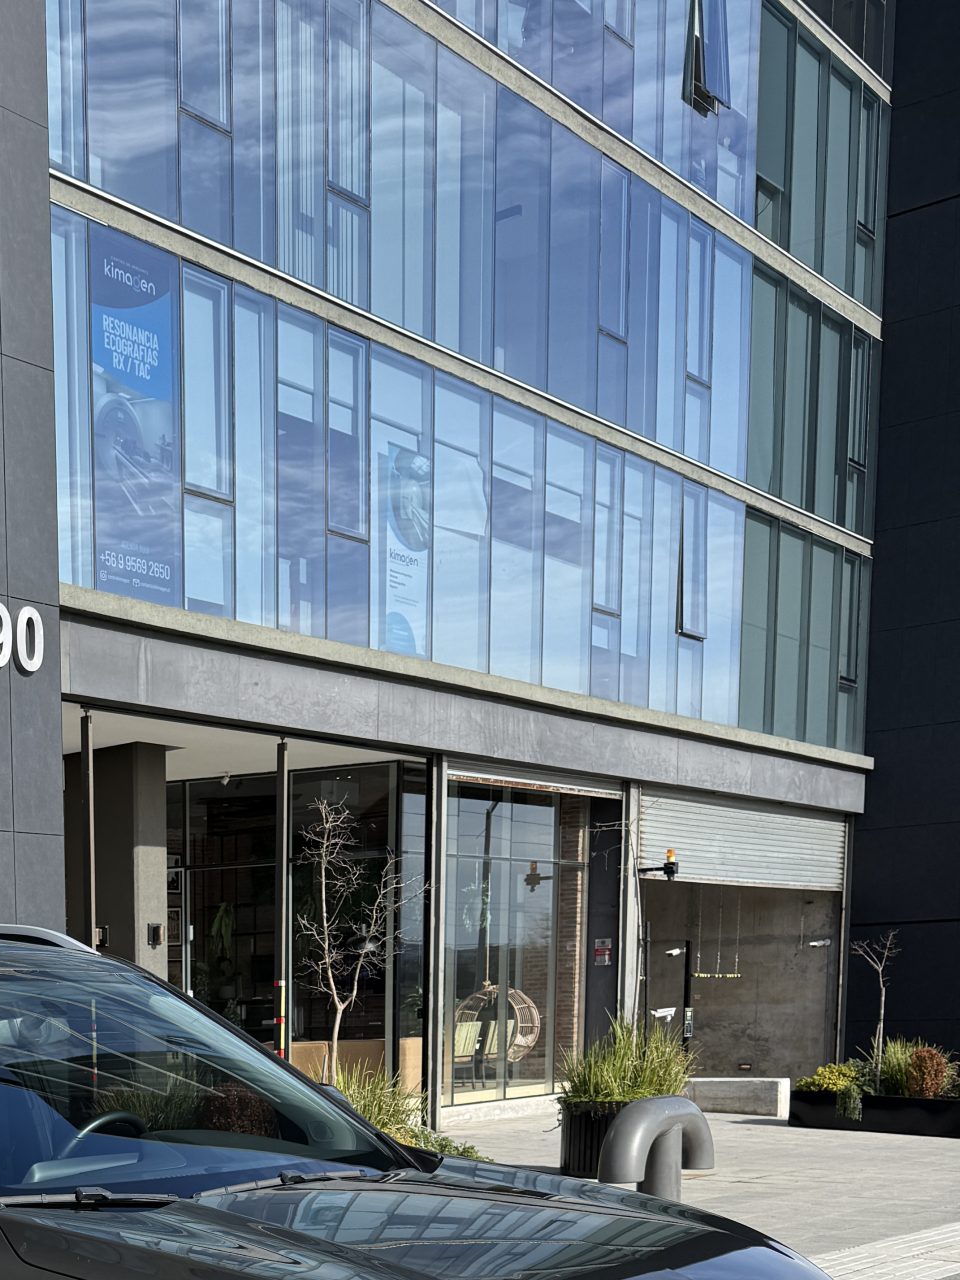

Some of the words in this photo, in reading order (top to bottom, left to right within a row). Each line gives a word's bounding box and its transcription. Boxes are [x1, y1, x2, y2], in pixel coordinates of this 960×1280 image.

[104, 258, 156, 296] kimagen
[103, 314, 159, 350] RESONANCIA
[104, 331, 159, 367] ECOGRAFIAS
[112, 351, 125, 371] RX
[134, 359, 151, 380] TAC
[100, 550, 117, 567] +56
[118, 554, 124, 569] 9
[125, 555, 147, 575] 9569
[148, 561, 171, 580] 2650
